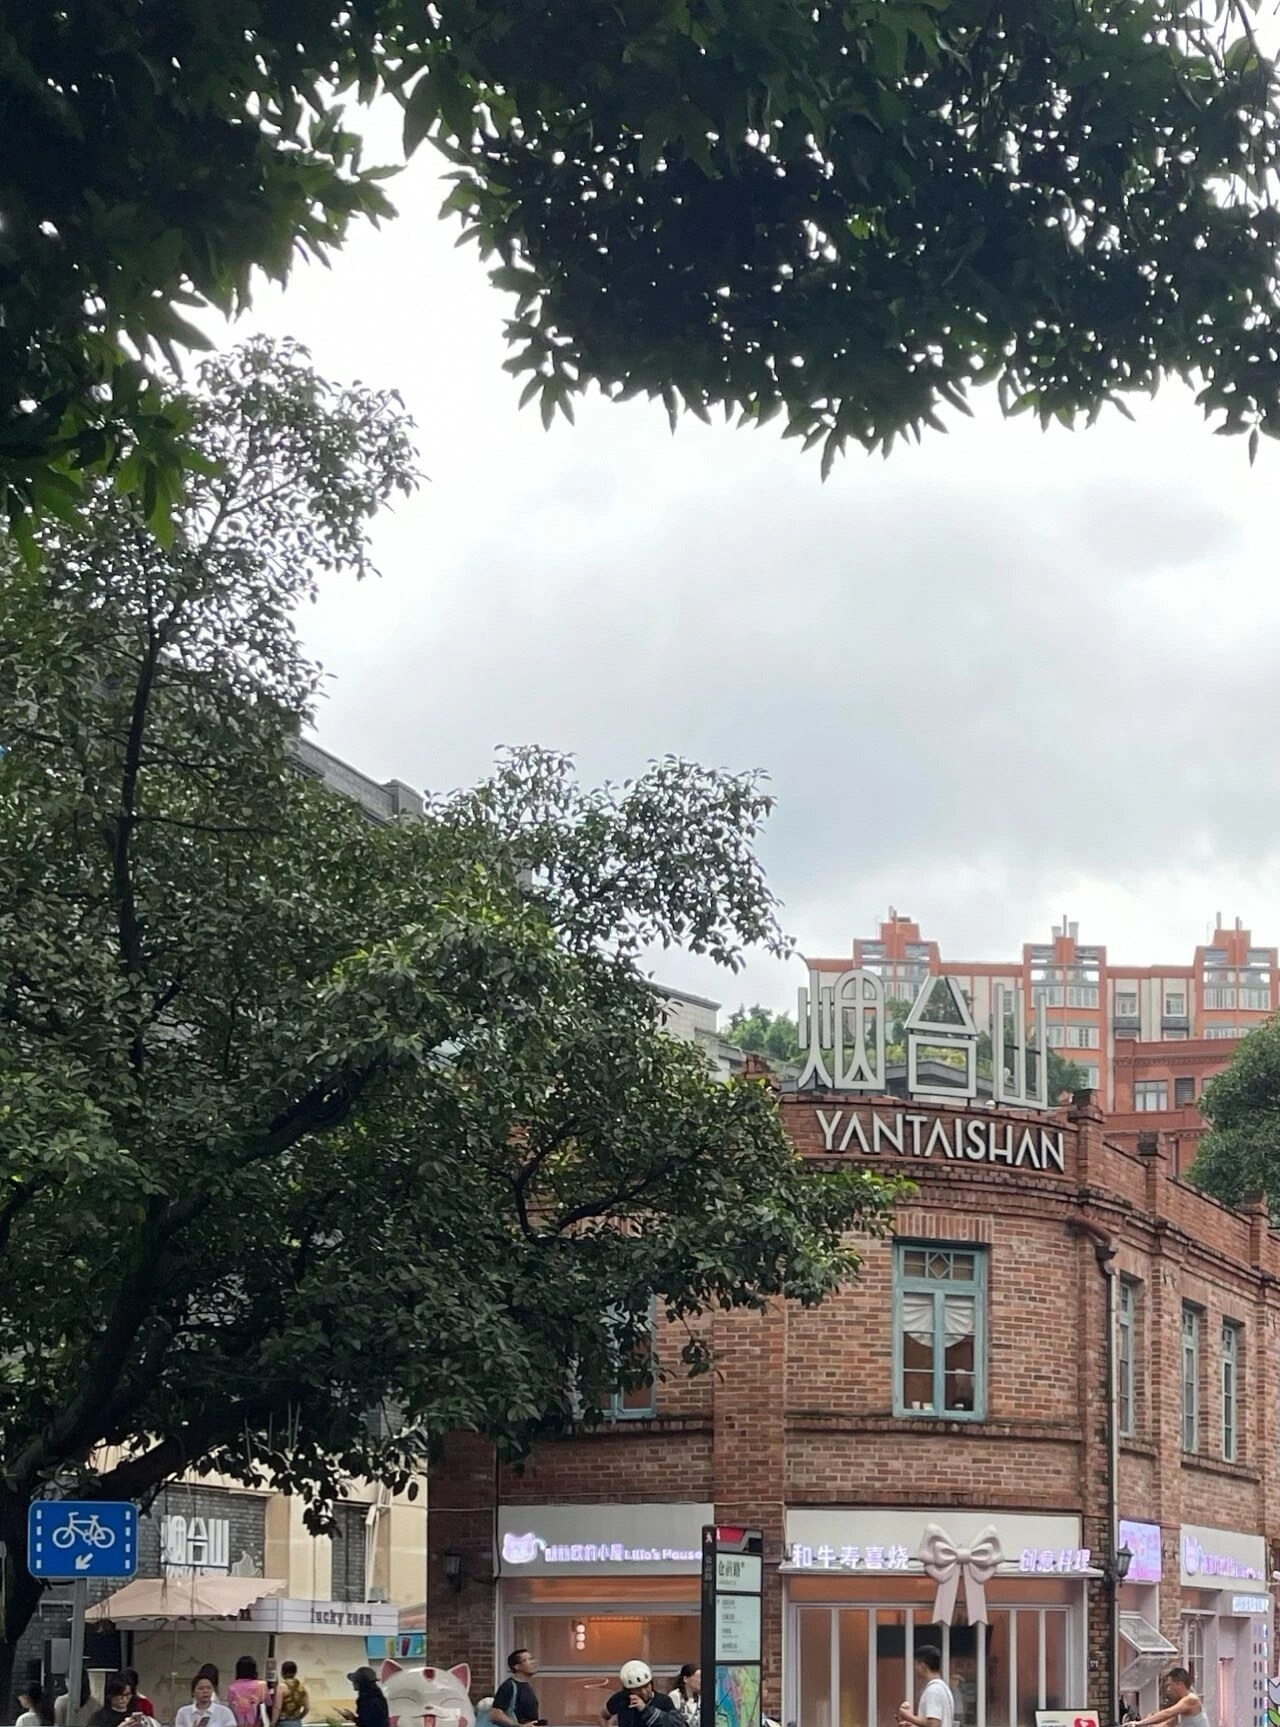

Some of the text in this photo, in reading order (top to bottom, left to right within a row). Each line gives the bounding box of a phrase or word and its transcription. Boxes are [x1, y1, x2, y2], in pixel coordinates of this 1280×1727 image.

[815, 1109, 1065, 1173] YANTAISHAN
[792, 1543, 1091, 1572] 和牛寿喜烧 创意料理
